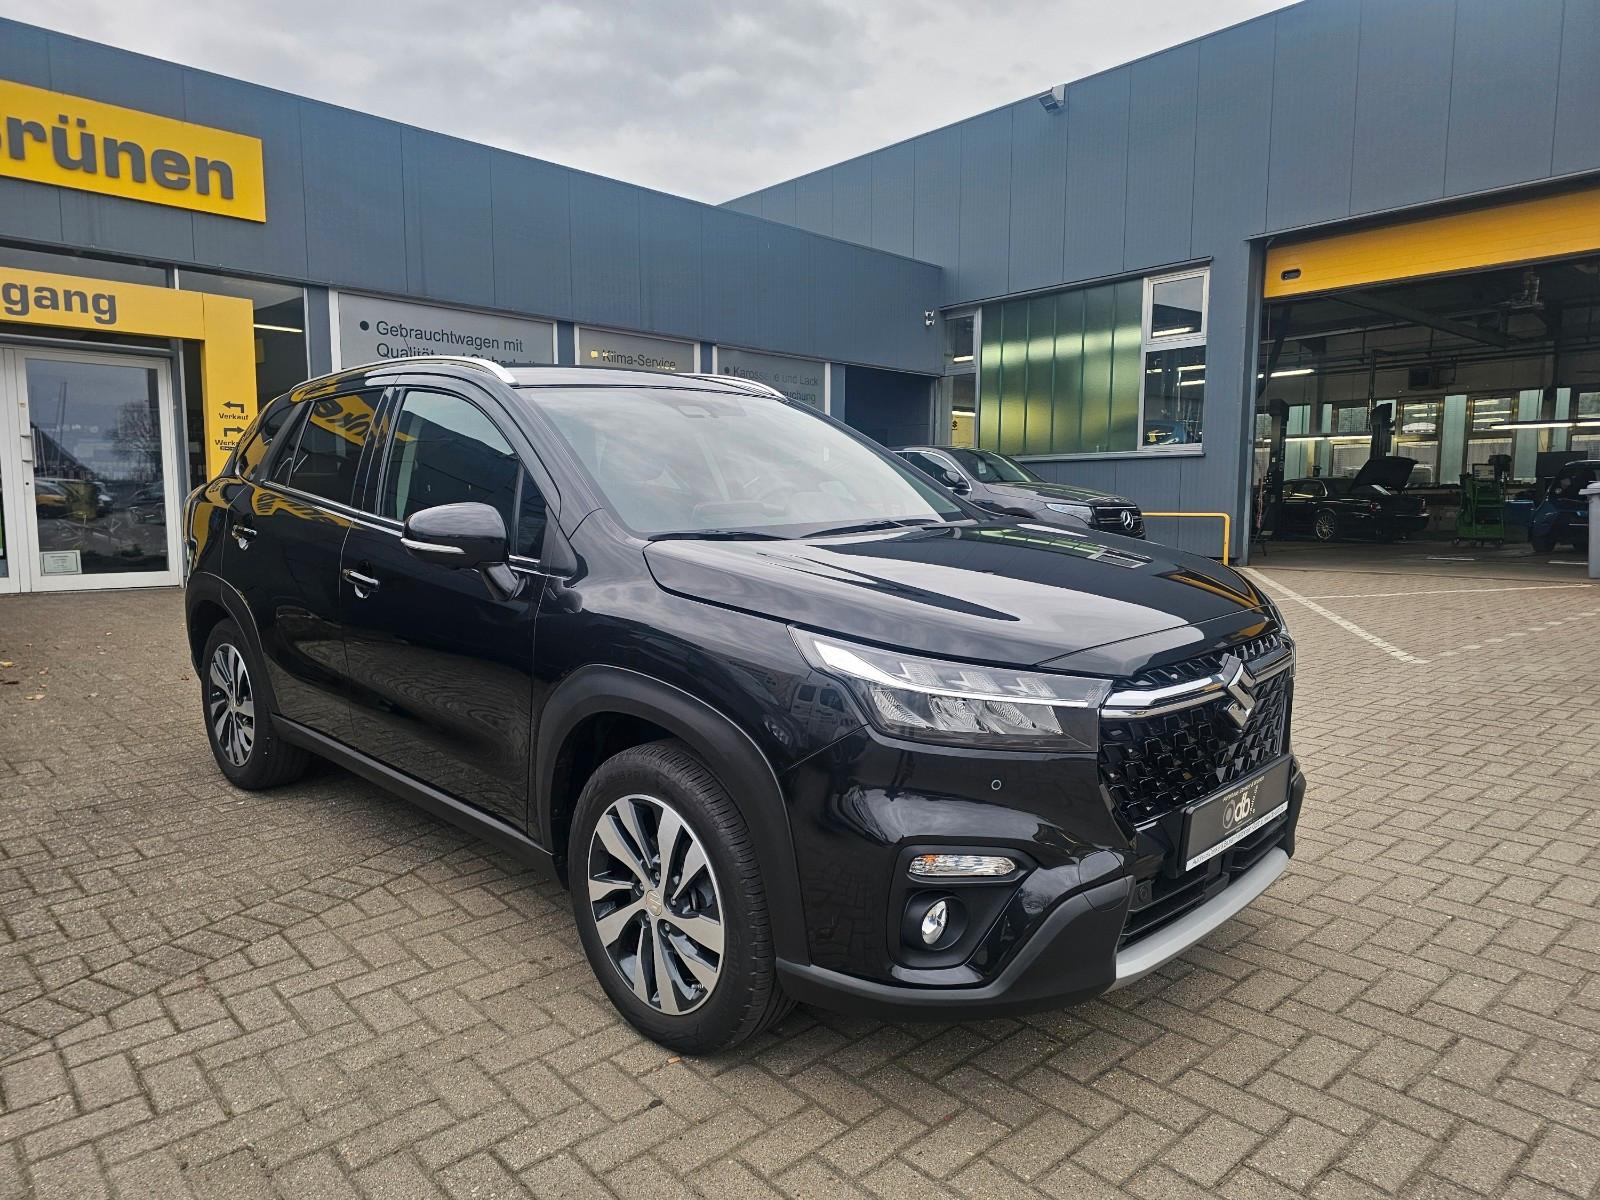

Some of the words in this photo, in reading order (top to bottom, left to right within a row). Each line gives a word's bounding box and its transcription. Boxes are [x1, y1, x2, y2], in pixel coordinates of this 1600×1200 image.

[0, 114, 234, 200] rünen
[2, 282, 118, 325] gang
[376, 320, 499, 350] Gebrauchtwagen
[504, 338, 523, 352] mit
[602, 349, 676, 370] Klima-Service
[799, 375, 818, 386] Lack
[218, 412, 249, 420] Verkauf
